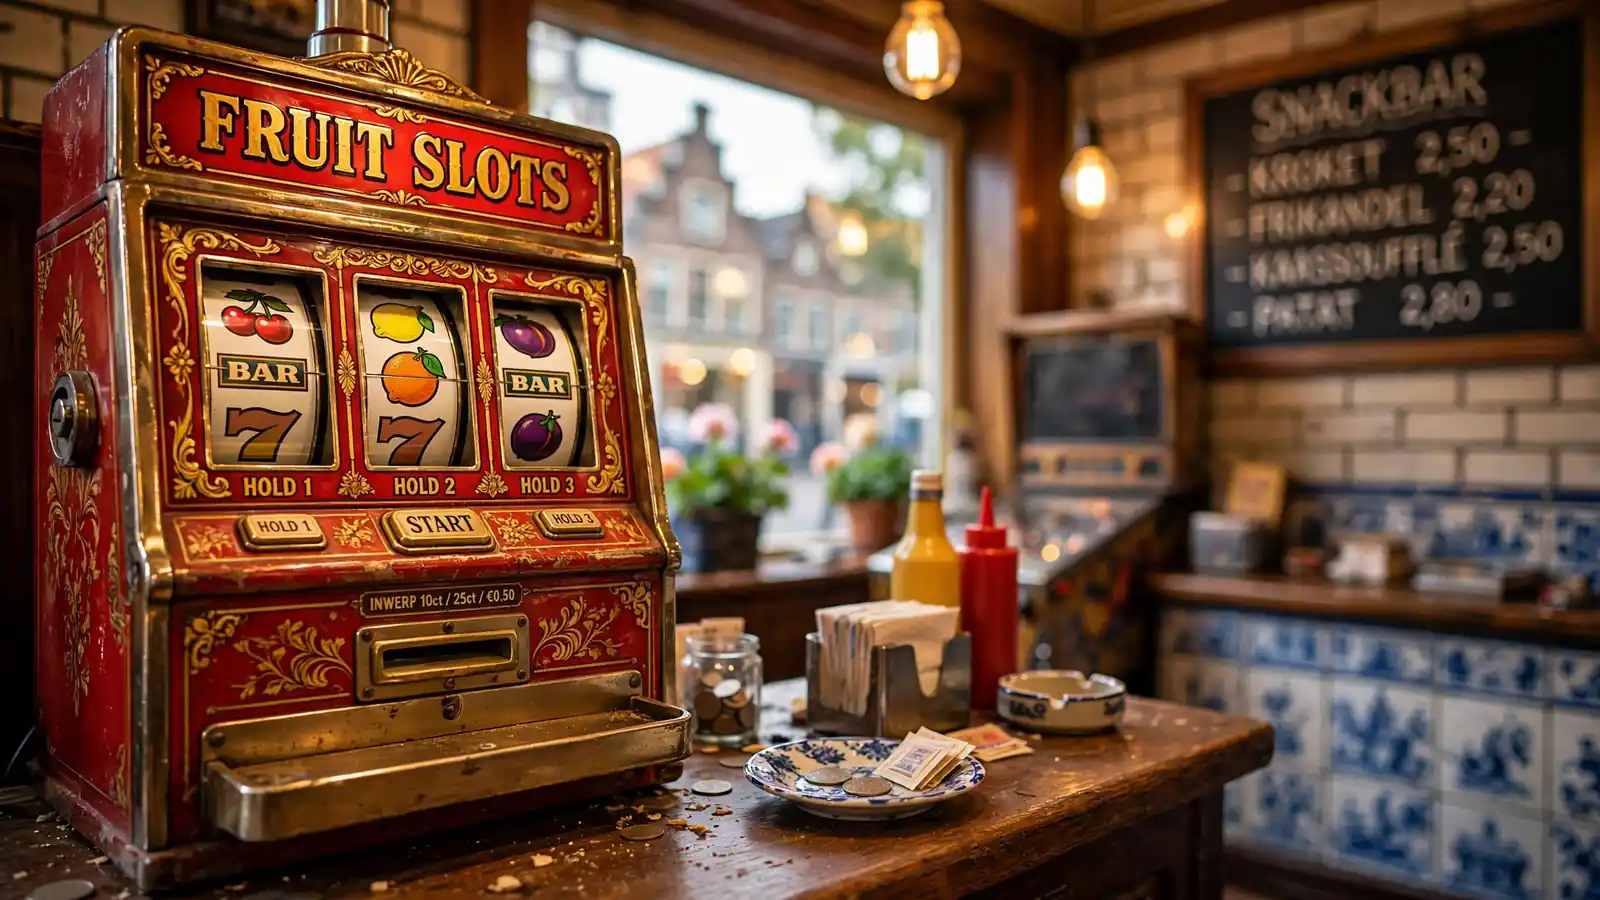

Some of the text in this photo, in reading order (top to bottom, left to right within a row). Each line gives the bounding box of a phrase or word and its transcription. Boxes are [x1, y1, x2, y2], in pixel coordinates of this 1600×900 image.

[1252, 53, 1488, 143] SNACKBAR
[200, 89, 571, 214] FRUIT SLOTS
[1249, 138, 1386, 198] KROKET
[1415, 121, 1501, 178] 2,50
[1453, 169, 1535, 222] 2,20
[1482, 219, 1564, 274] 2,50
[228, 361, 300, 384] BAR
[512, 373, 566, 394] BAR
[244, 477, 313, 497] HOLD 1
[394, 477, 457, 496] HOLD 2
[521, 477, 575, 494] HOLD 3
[257, 520, 313, 533] HOLD 1
[406, 514, 475, 534] START
[552, 512, 595, 525] HOLD 3
[370, 595, 417, 611] INWERP
[420, 594, 443, 608] 10ct
[453, 592, 477, 605] 25ct
[487, 589, 515, 603] €0.50
